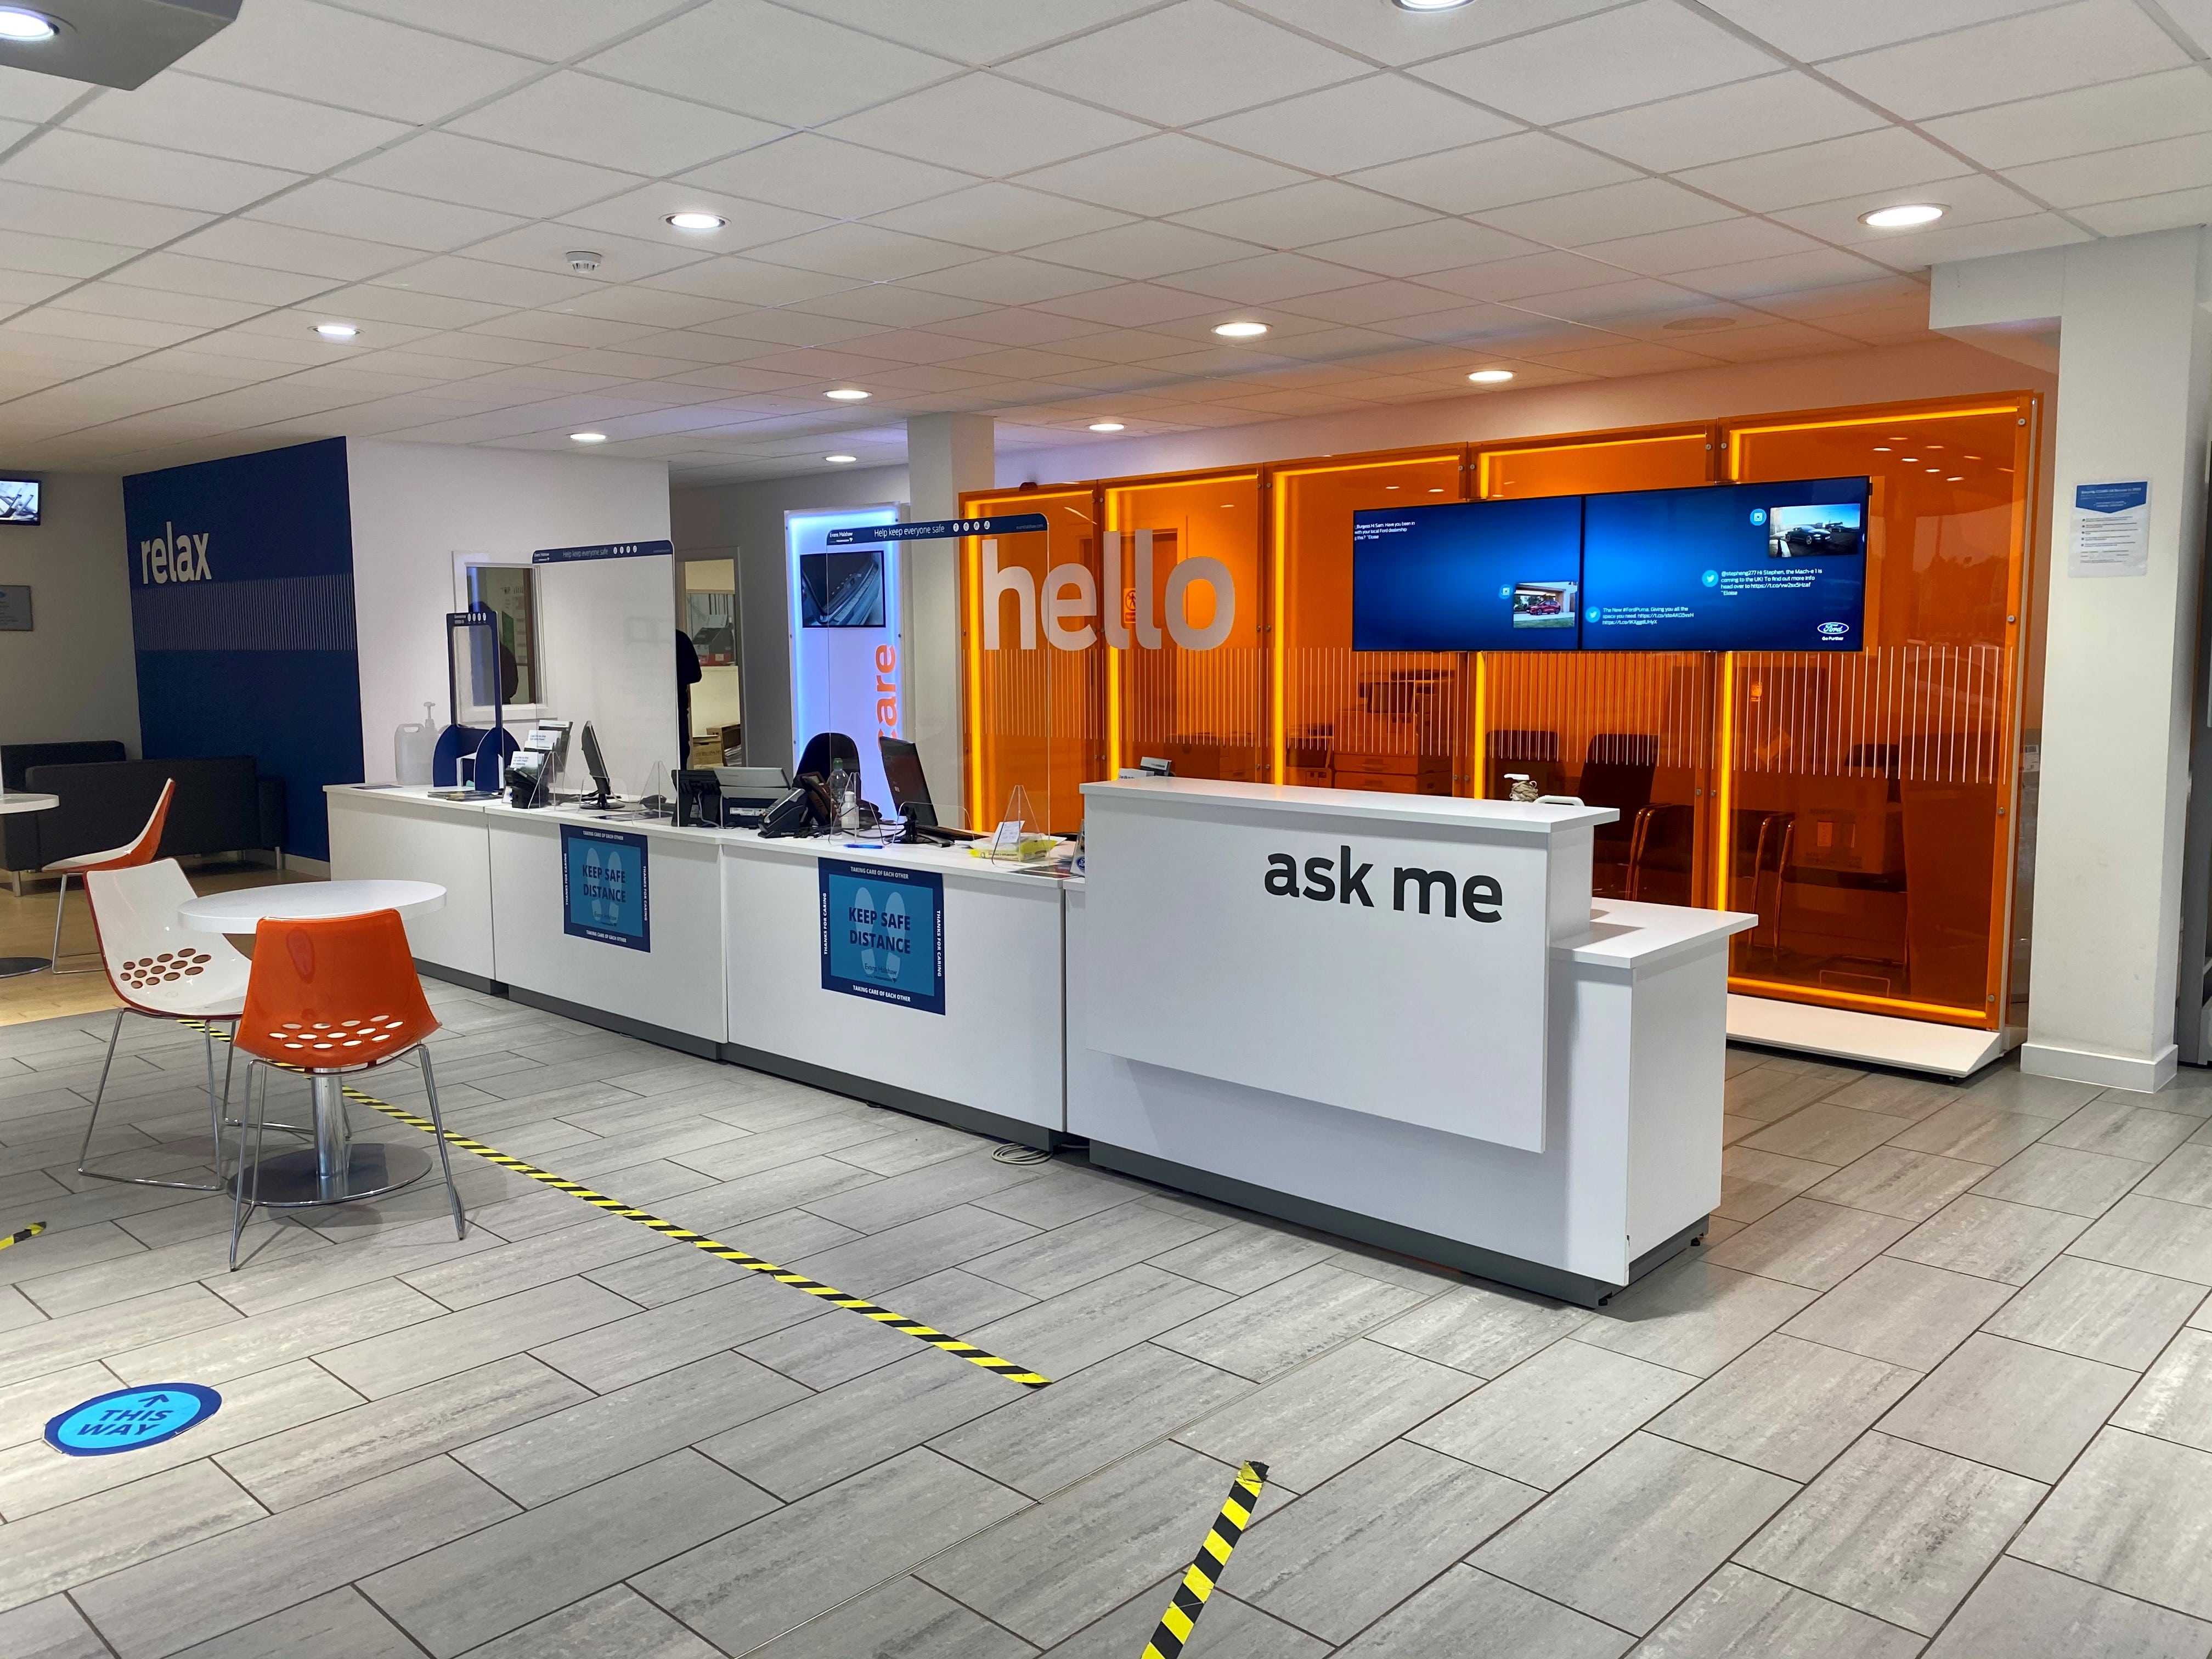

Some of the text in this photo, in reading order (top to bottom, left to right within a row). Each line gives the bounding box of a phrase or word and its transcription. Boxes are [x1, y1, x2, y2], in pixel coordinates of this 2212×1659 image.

[874, 524, 945, 539] Help keep everyone safe
[140, 521, 212, 584] relax
[562, 548, 608, 558] Help keep everyone safe
[982, 529, 1235, 651] hello
[583, 864, 625, 883] KEEP SAFE
[583, 883, 626, 903] DISTANCE
[1265, 845, 1503, 923] ask me
[849, 907, 911, 931] KEEP SAFE
[849, 929, 911, 955] DISTANCE
[865, 963, 877, 971] Evans
[853, 985, 868, 993] TAKING
[99, 1410, 174, 1421] THIS
[77, 1424, 161, 1436] WAY
